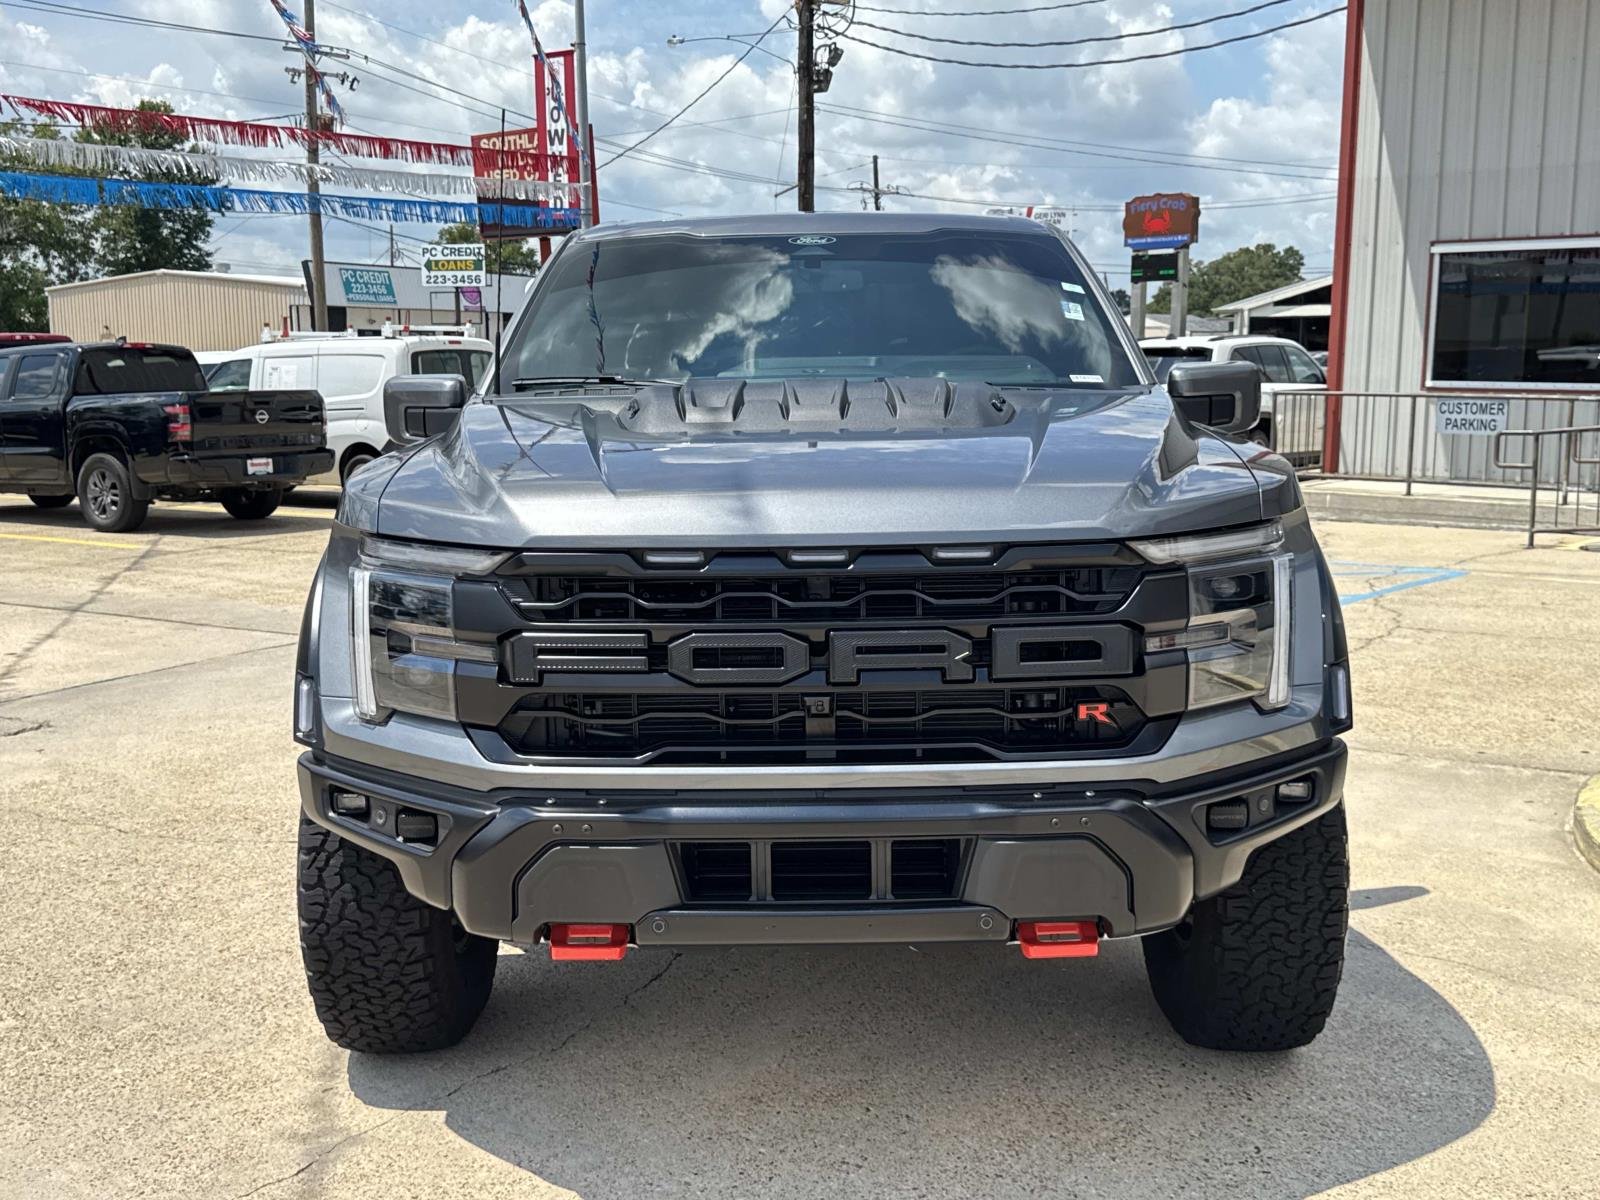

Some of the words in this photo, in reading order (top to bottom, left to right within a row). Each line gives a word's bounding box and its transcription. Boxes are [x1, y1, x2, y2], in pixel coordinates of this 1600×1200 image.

[1130, 202, 1157, 215] Fiery
[1159, 197, 1186, 211] Crab
[422, 247, 438, 258] PC
[441, 246, 484, 258] CREDIT
[431, 260, 474, 271] LOANS
[341, 270, 356, 282] PC
[356, 271, 390, 285] CREDIT
[351, 283, 387, 295] 223-3456
[1439, 402, 1505, 416] CUSTOMER
[1445, 417, 1497, 432] PARKING
[504, 623, 1134, 684] FORD
[1078, 703, 1113, 725] R
